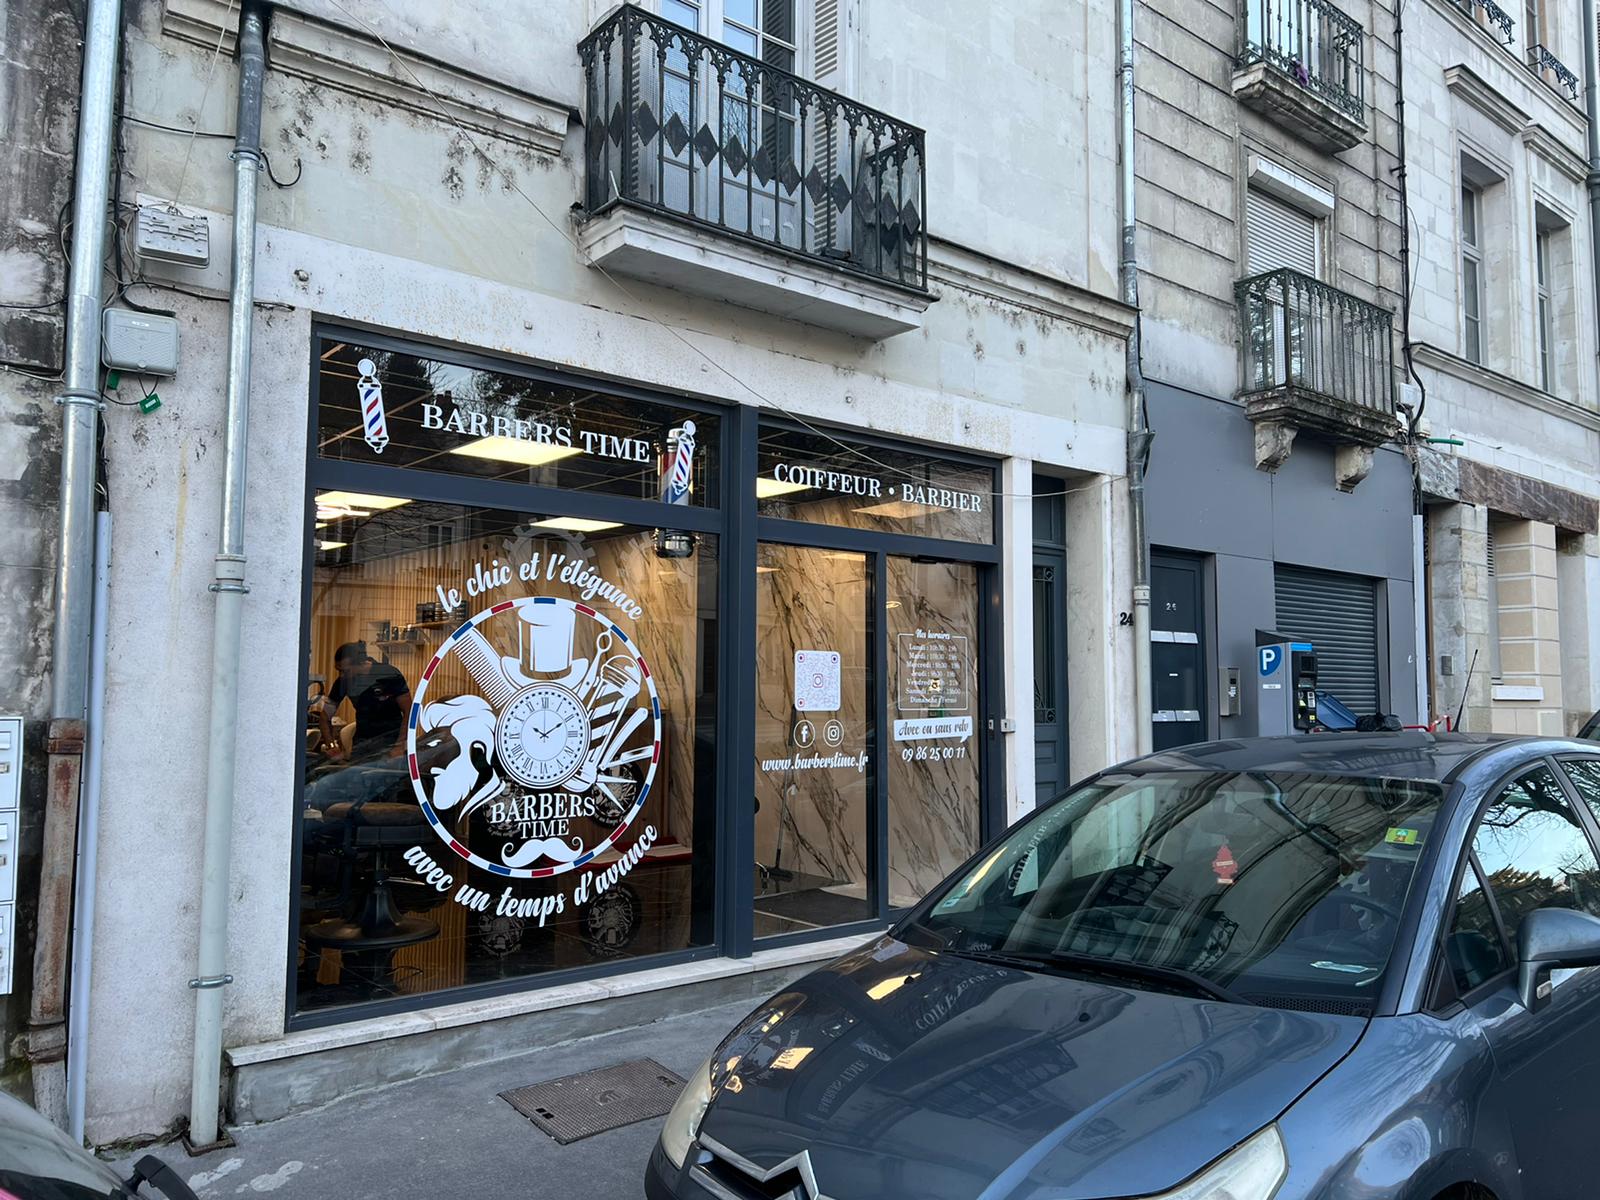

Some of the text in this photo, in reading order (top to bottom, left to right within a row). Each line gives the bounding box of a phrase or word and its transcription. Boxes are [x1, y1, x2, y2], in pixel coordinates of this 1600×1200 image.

[420, 403, 650, 463] BARBERS TIME
[774, 463, 982, 512] COIFFEUR BARBIER
[436, 552, 643, 620] le chic et l'élégance
[1120, 612, 1134, 626] 24
[1262, 649, 1276, 671] P
[898, 721, 920, 736] Avec
[935, 723, 952, 734] sans
[954, 720, 969, 732] rdv
[761, 750, 869, 772] www.barberstime.fr
[902, 746, 966, 762] 09 86 25 00 11
[490, 793, 595, 824] BARBERS
[517, 818, 570, 840] TIME
[403, 824, 658, 928] avec un temps d'avance
